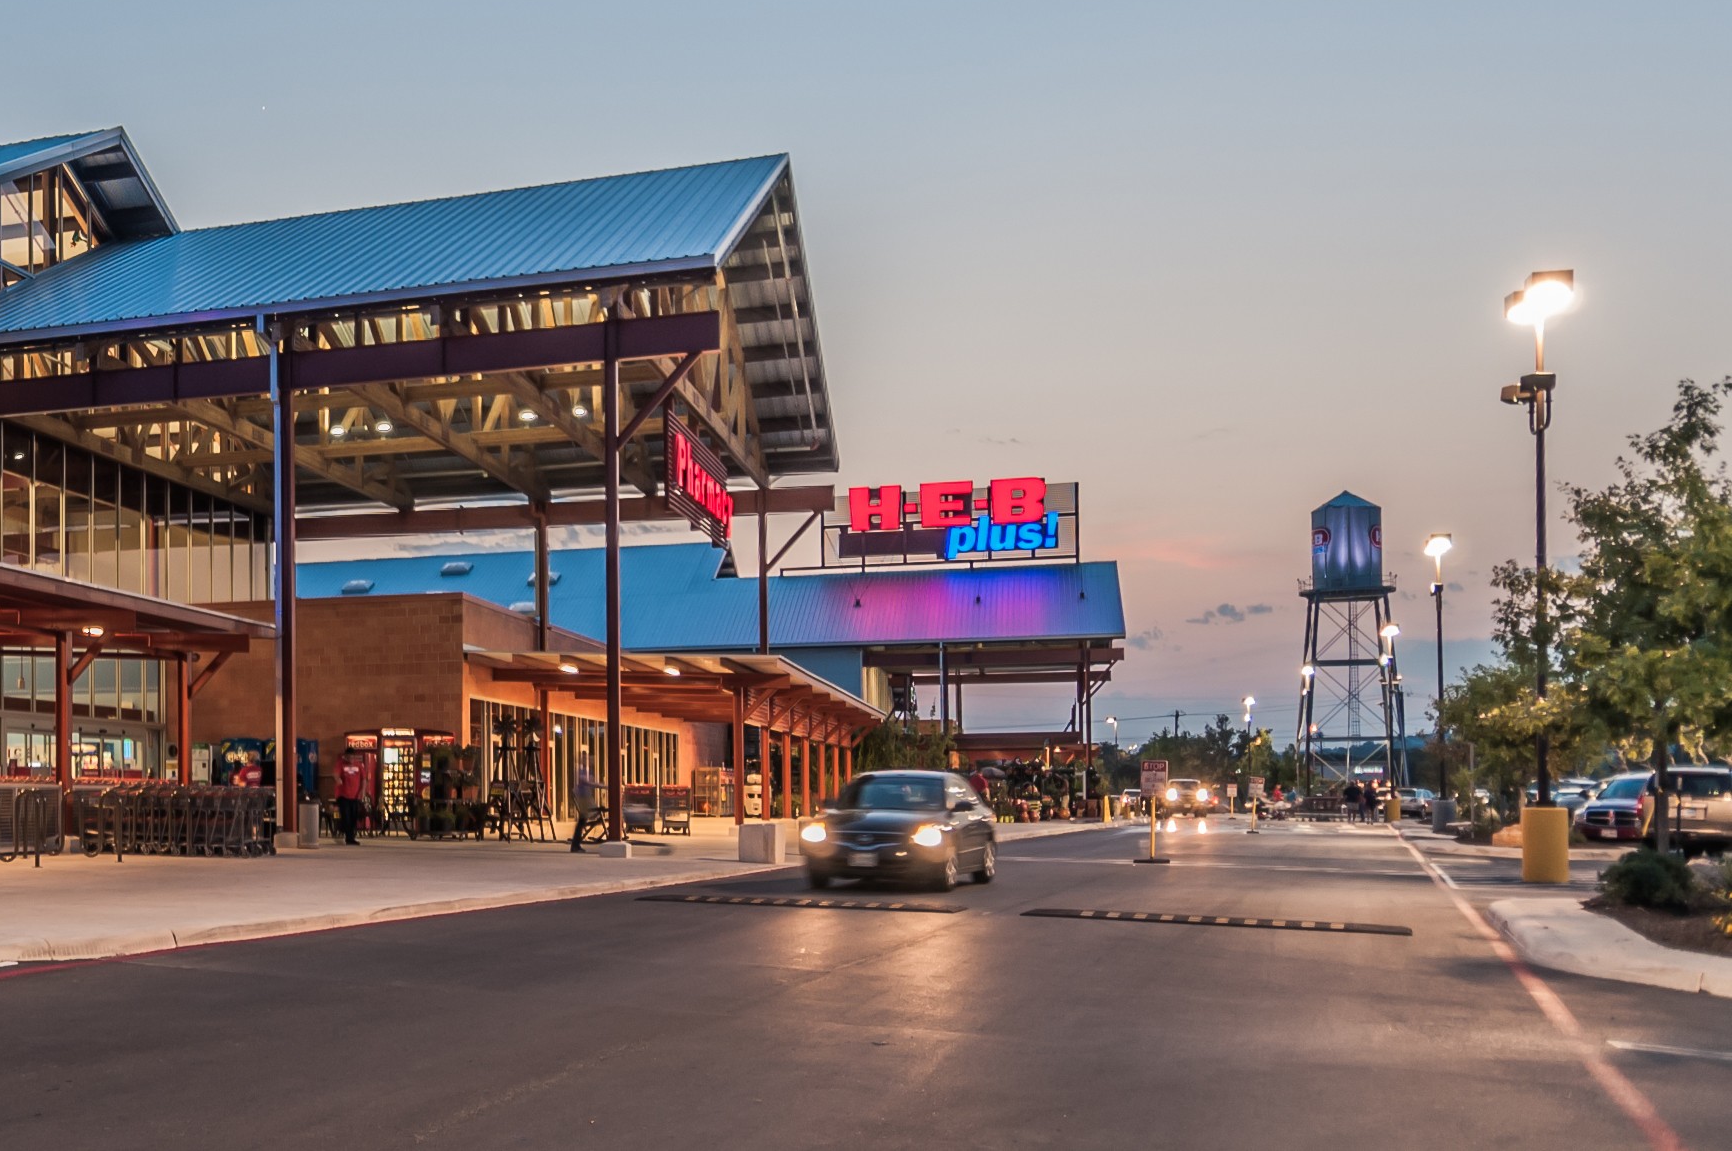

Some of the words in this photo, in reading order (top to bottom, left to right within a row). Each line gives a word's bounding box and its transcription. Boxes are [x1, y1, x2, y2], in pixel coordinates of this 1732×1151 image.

[675, 432, 734, 540] Pharmacy
[849, 476, 1047, 532] H-E-B
[945, 511, 1059, 560] plus!
[348, 738, 374, 749] redbox
[1143, 761, 1165, 770] STOP
